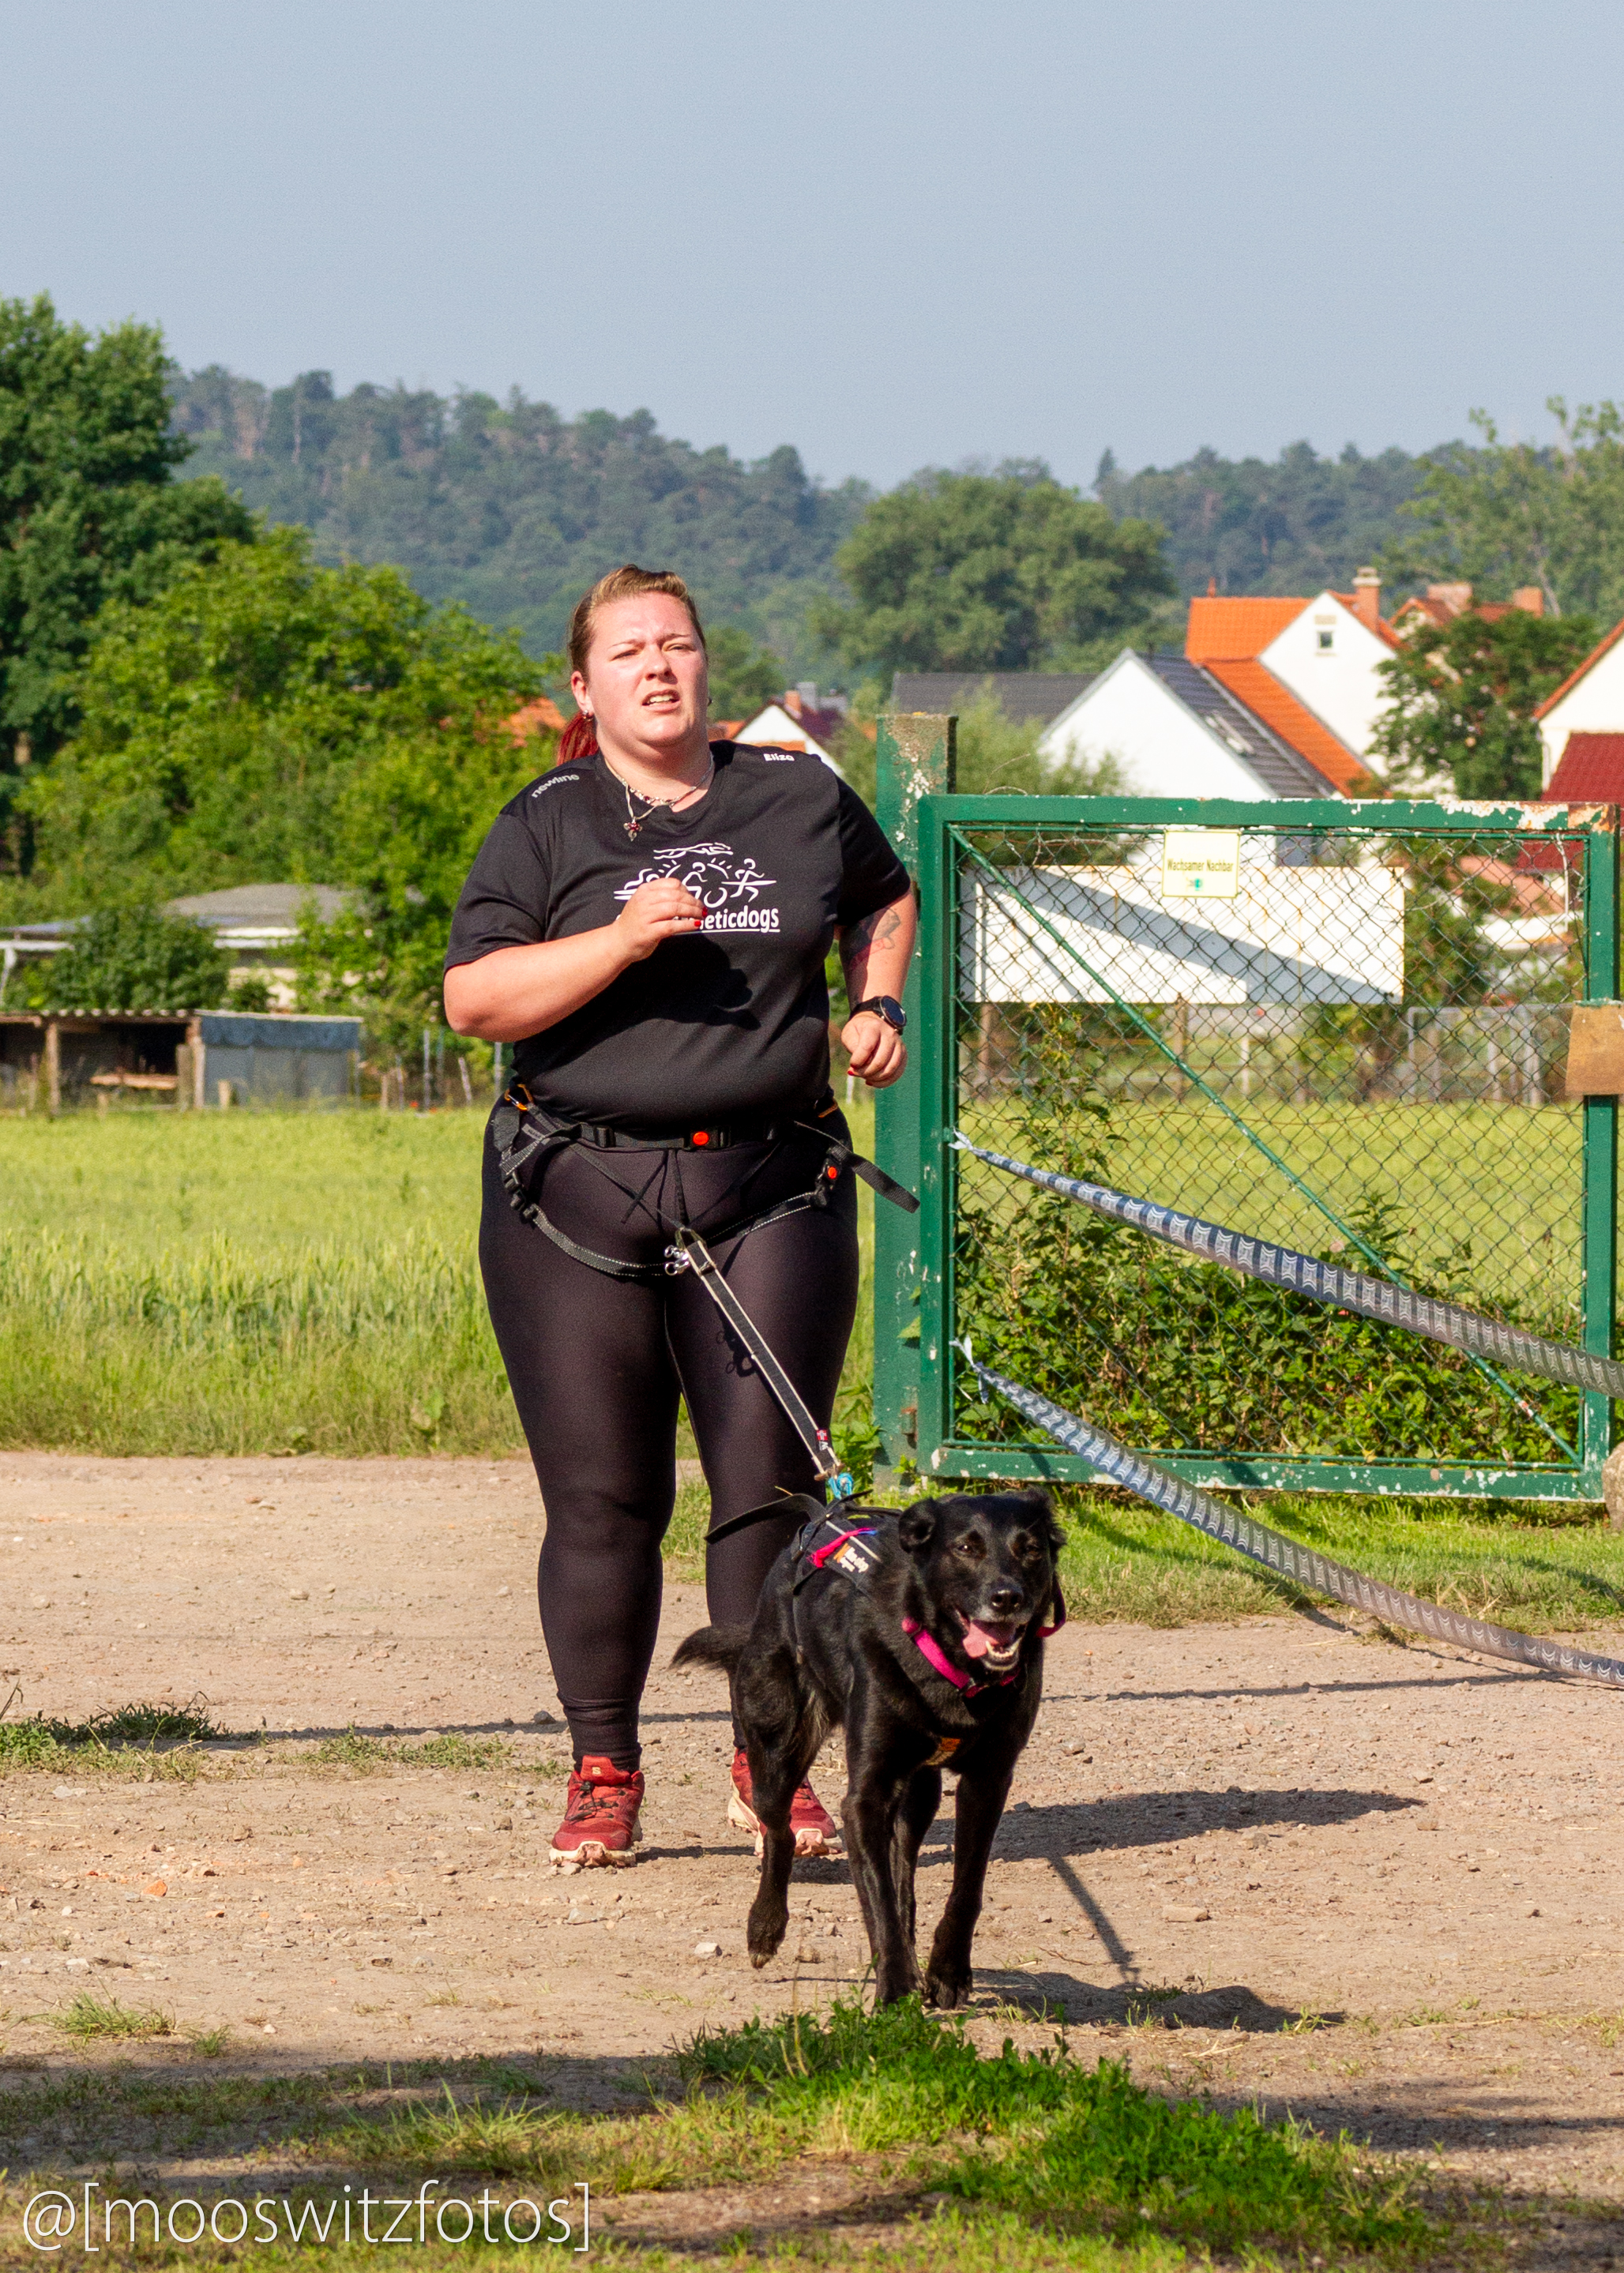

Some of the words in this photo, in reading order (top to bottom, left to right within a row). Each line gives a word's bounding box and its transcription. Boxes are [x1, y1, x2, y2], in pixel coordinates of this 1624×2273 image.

[763, 753, 795, 761] Eliza
[532, 774, 580, 798] newline
[1167, 858, 1205, 871] Wachsamer
[1206, 858, 1234, 872] Nachbar
